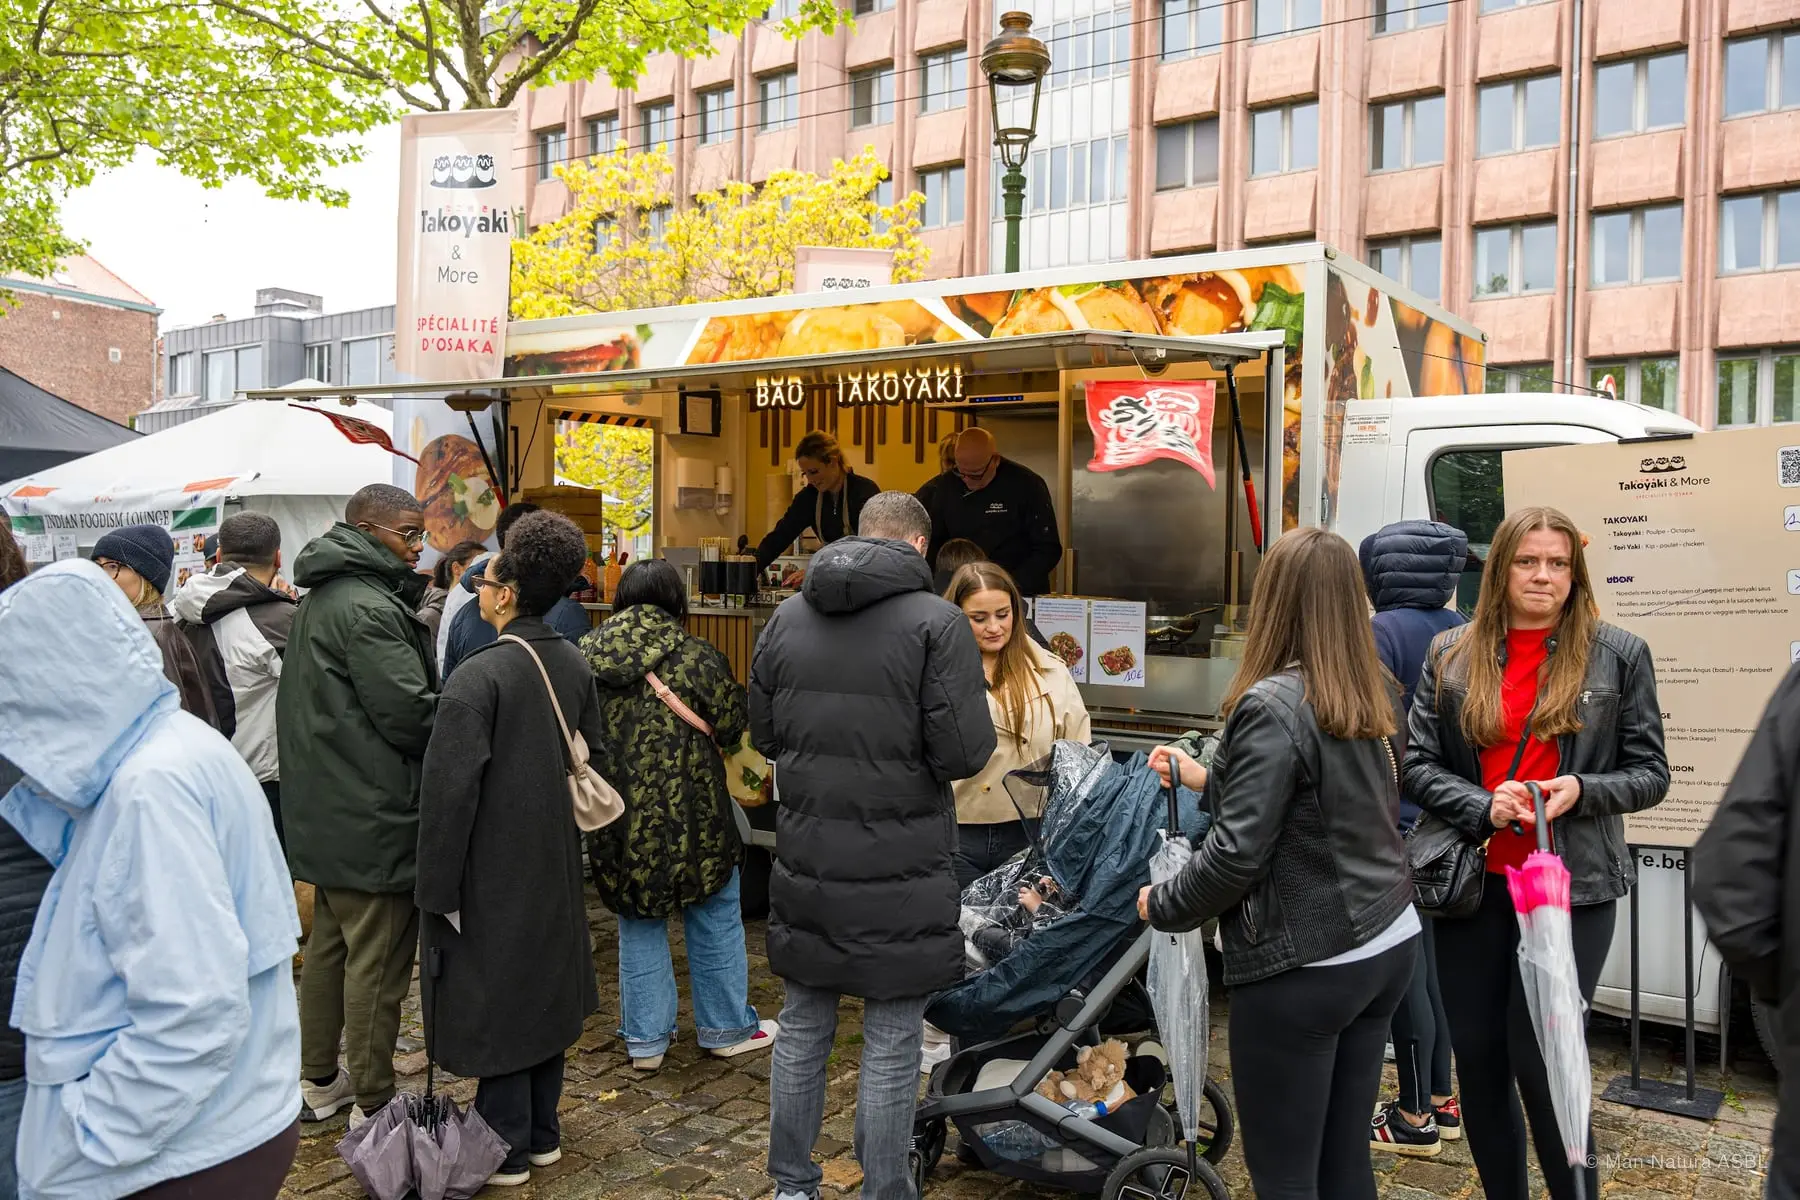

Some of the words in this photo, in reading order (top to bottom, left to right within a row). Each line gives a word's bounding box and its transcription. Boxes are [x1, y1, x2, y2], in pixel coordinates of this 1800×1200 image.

[421, 208, 508, 238] Takoyaki
[451, 244, 461, 260] &
[438, 265, 478, 284] More
[417, 314, 498, 334] SPÉCIALITÉ
[422, 338, 493, 354] D'OSAKA
[756, 386, 803, 407] BAO
[1618, 479, 1667, 491] Takoyaki
[1669, 477, 1678, 487] &
[1680, 476, 1711, 486] More
[45, 513, 79, 529] INDIAN
[80, 511, 124, 529] FOODISM
[126, 510, 169, 526] LOUNGE
[1603, 515, 1648, 524] TAKOYAKI
[1669, 765, 1695, 773] UDON
